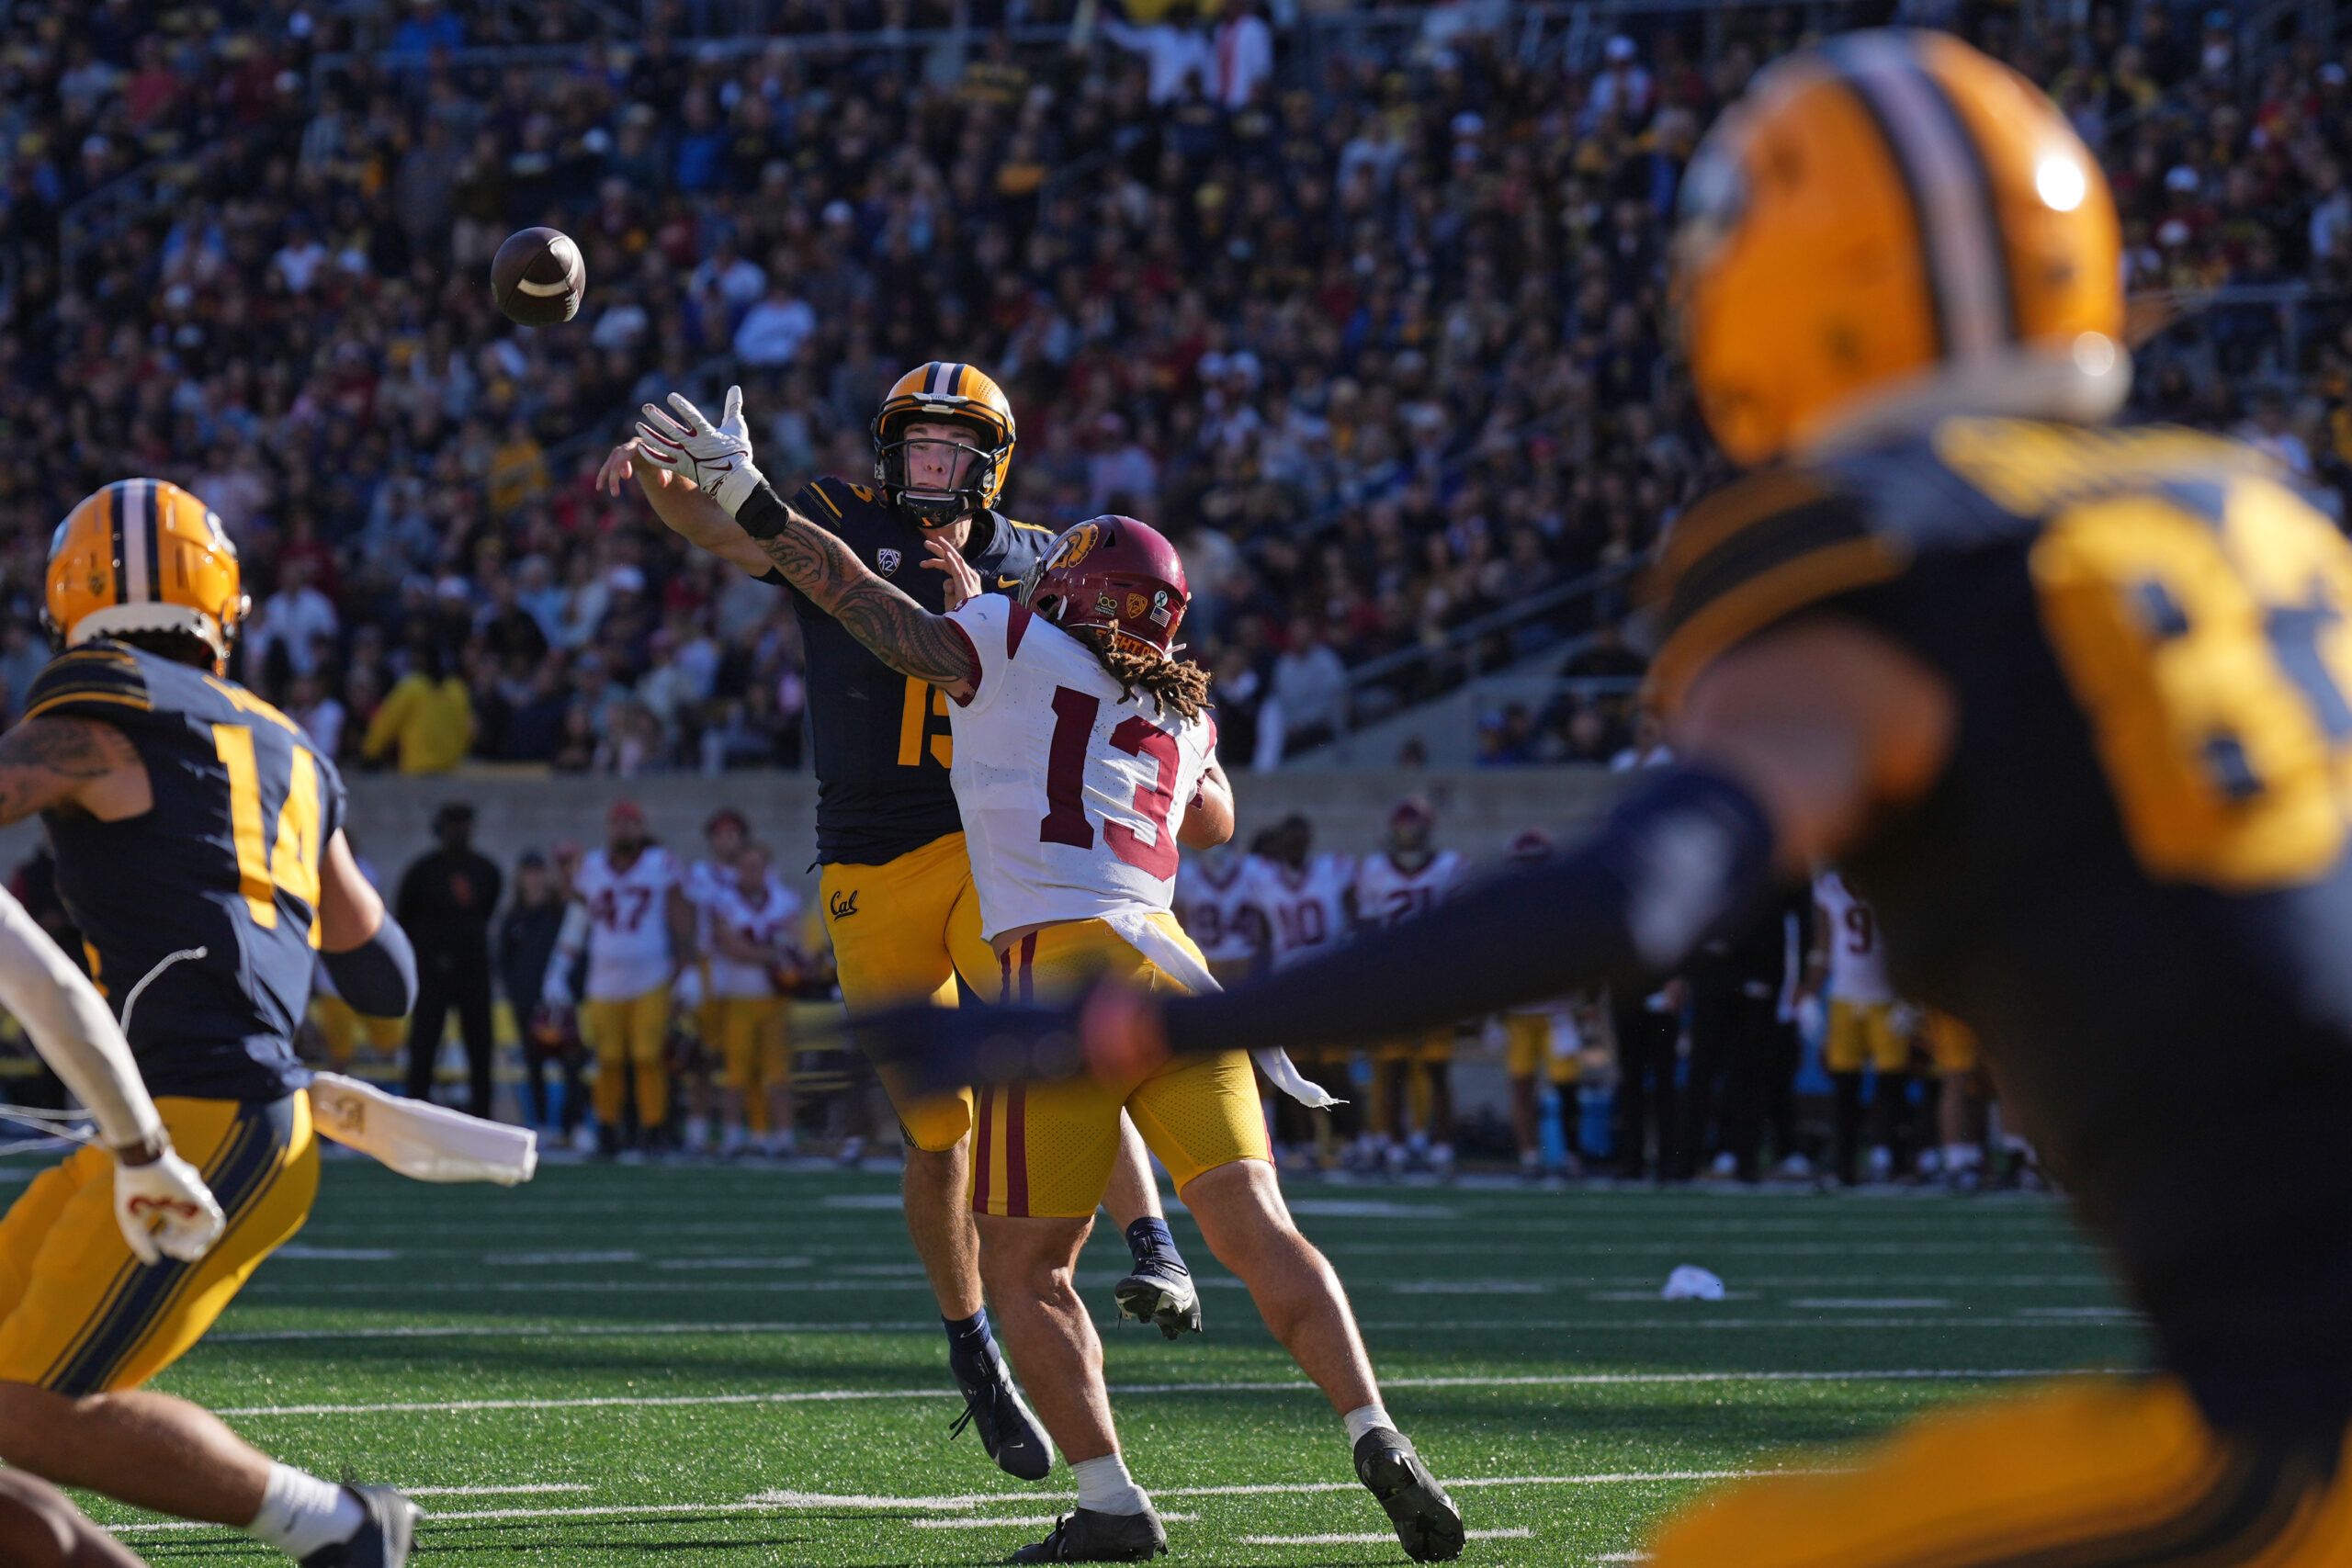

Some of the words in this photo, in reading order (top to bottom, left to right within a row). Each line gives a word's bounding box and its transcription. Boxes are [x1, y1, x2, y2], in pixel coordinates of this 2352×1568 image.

[879, 549, 900, 567] PAC
[882, 560, 894, 571] 12
[1097, 592, 1118, 609] 100
[1040, 685, 1181, 883] 13
[211, 723, 322, 951] 14
[589, 886, 652, 934] 47
[830, 889, 858, 921] Cal
